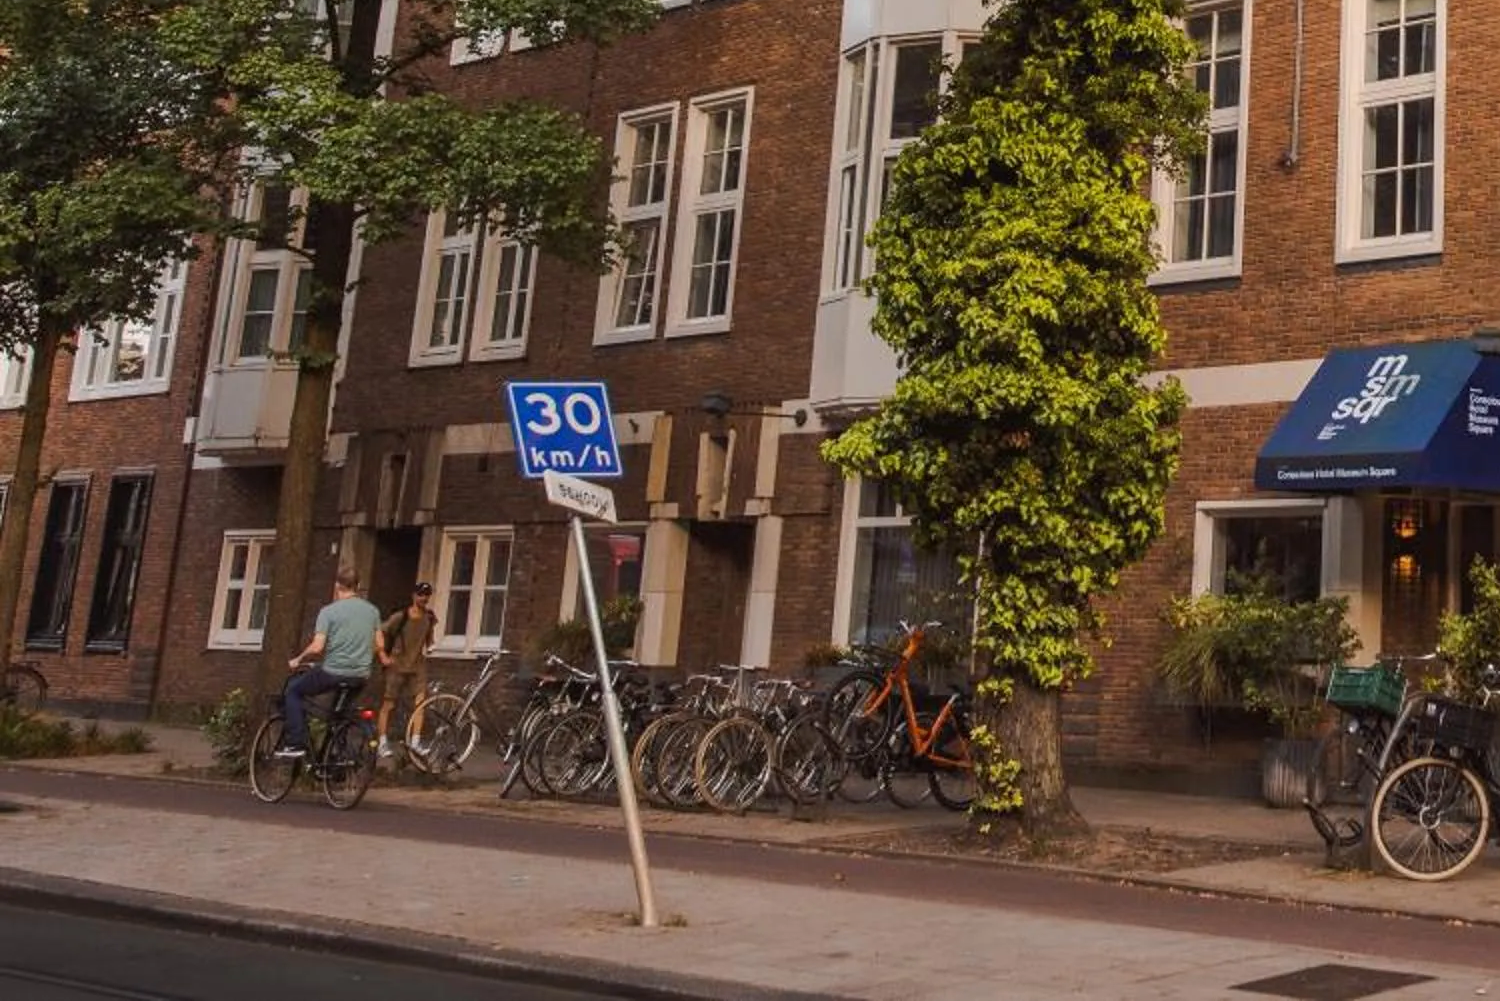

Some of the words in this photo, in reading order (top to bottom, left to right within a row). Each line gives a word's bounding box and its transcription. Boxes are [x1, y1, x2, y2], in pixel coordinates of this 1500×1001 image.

[525, 392, 601, 435] 30
[1331, 396, 1398, 424] sqr
[530, 444, 612, 468] km/h
